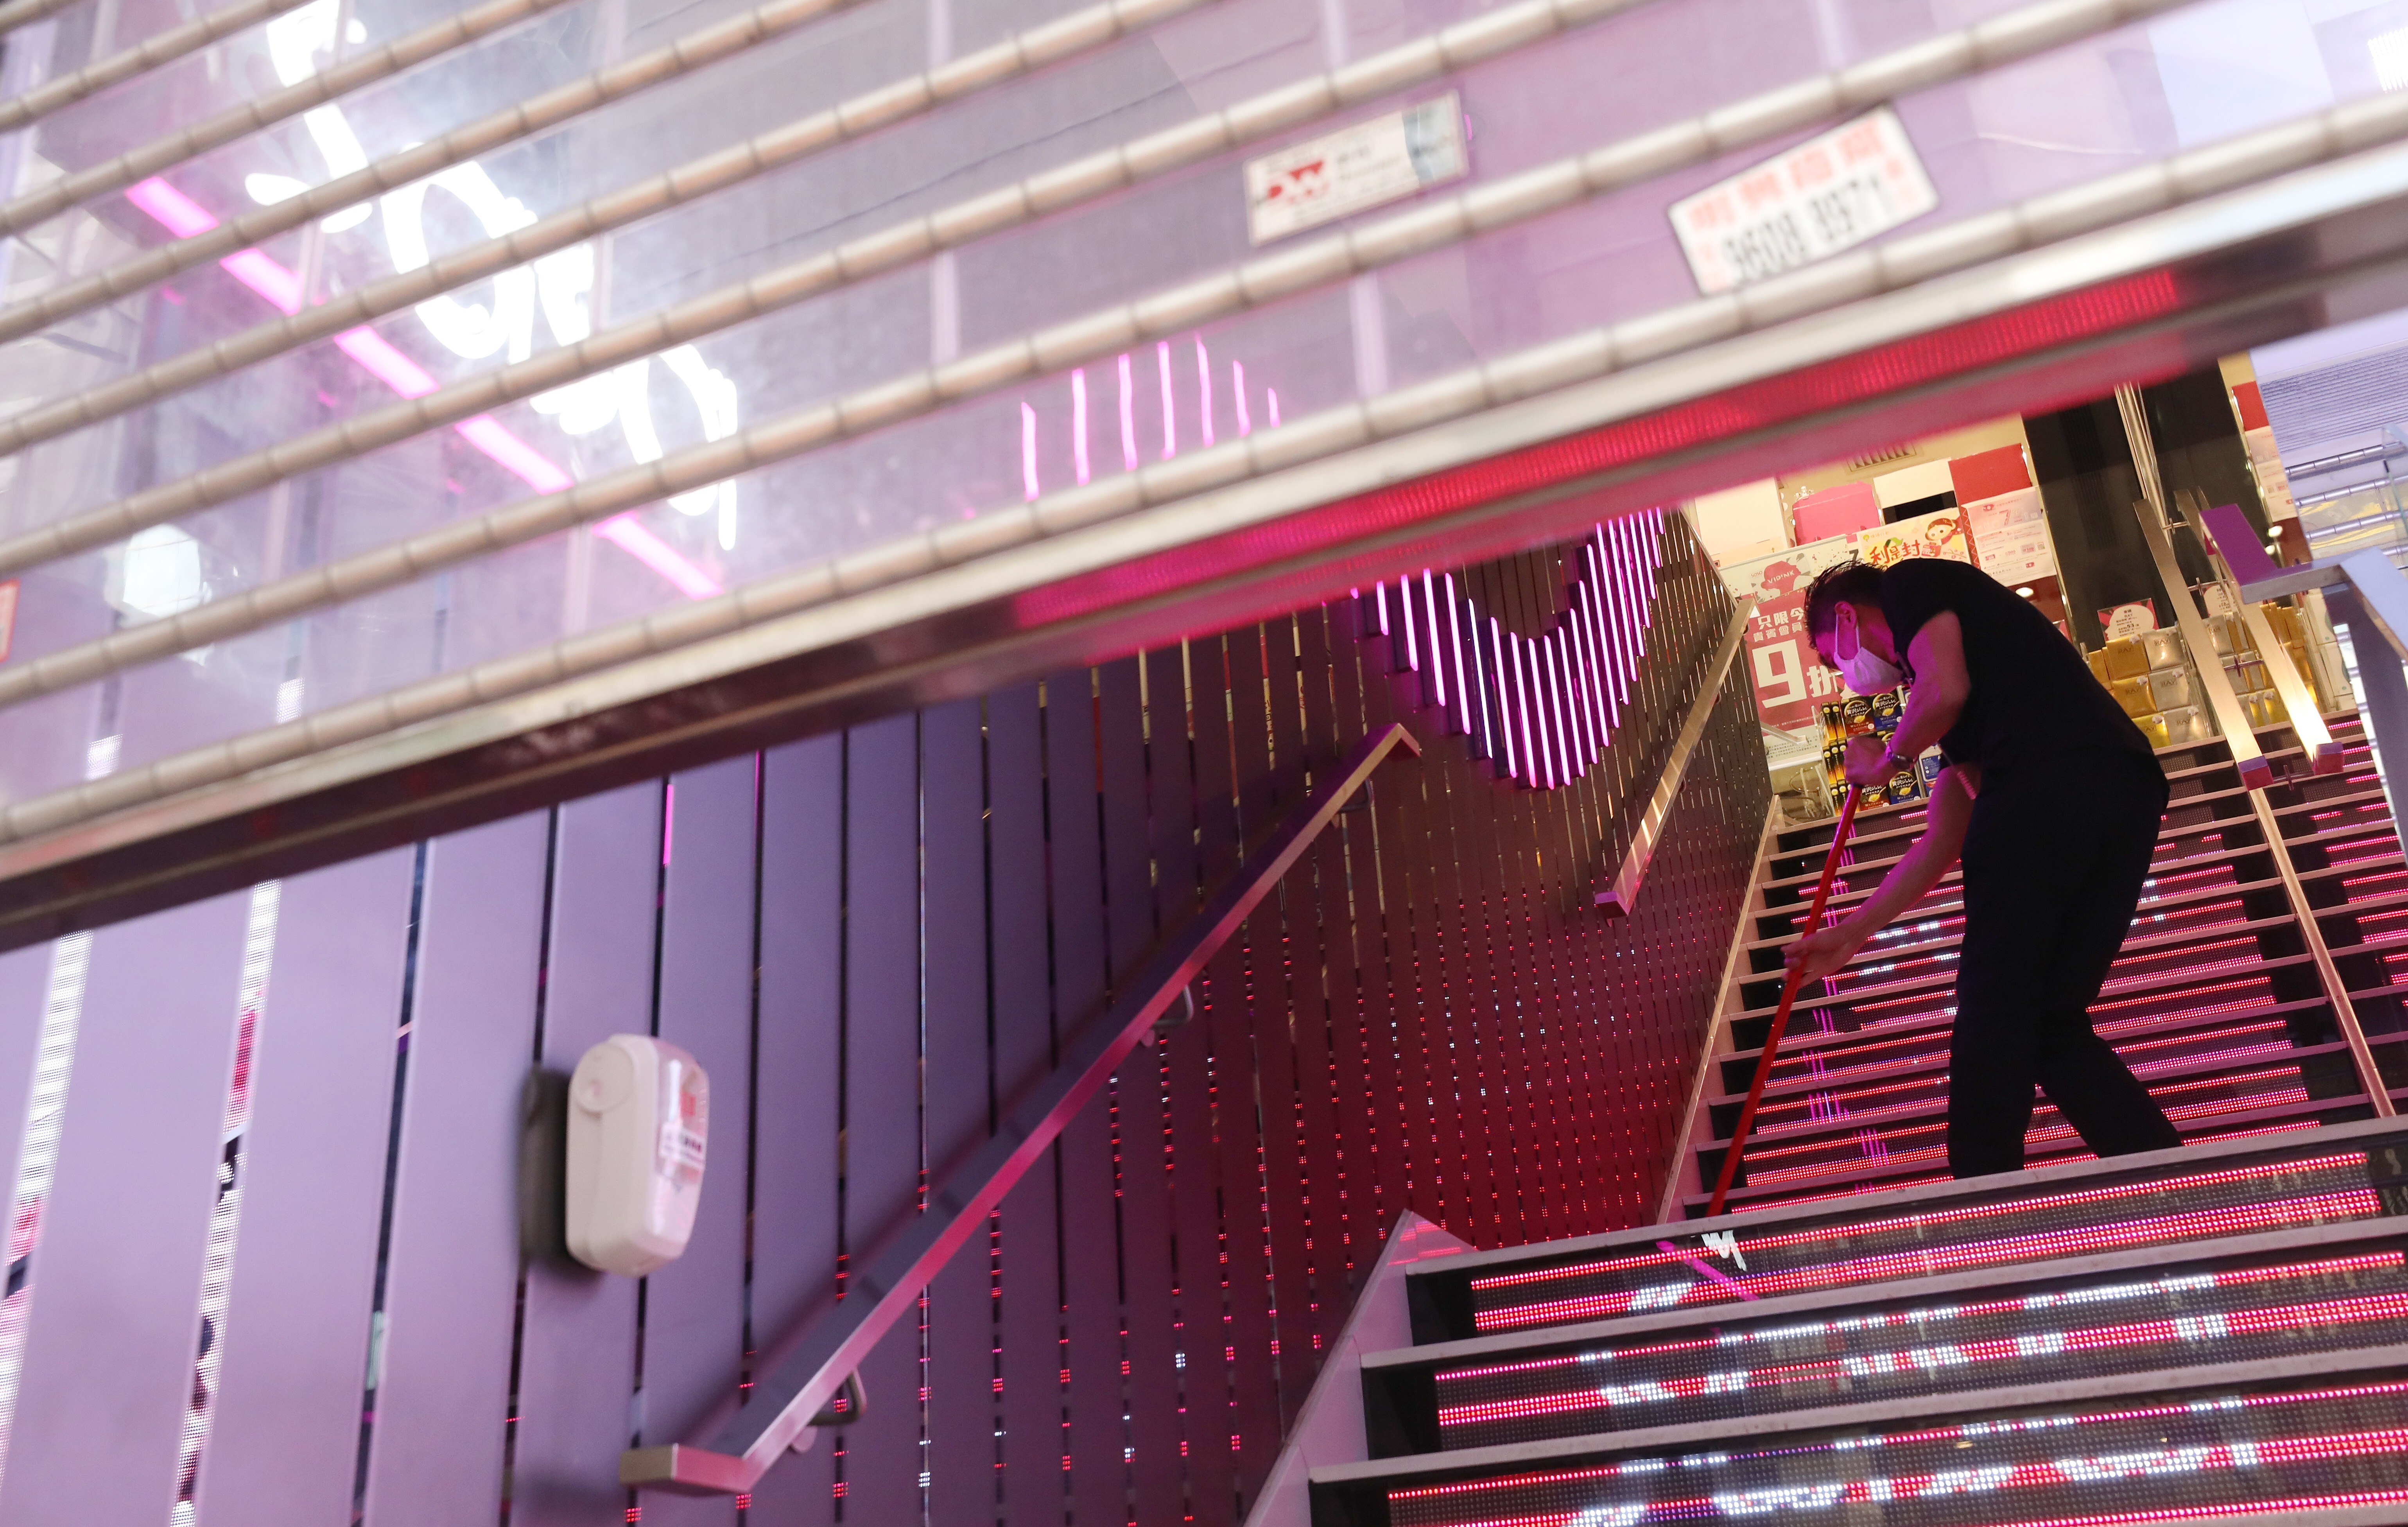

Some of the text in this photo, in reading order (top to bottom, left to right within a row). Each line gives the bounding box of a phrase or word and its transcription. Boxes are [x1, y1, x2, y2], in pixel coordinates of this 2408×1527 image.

[1869, 539, 1920, 564] 利是封
[1757, 606, 1808, 630] 只限今
[1752, 639, 1838, 709] 9折
